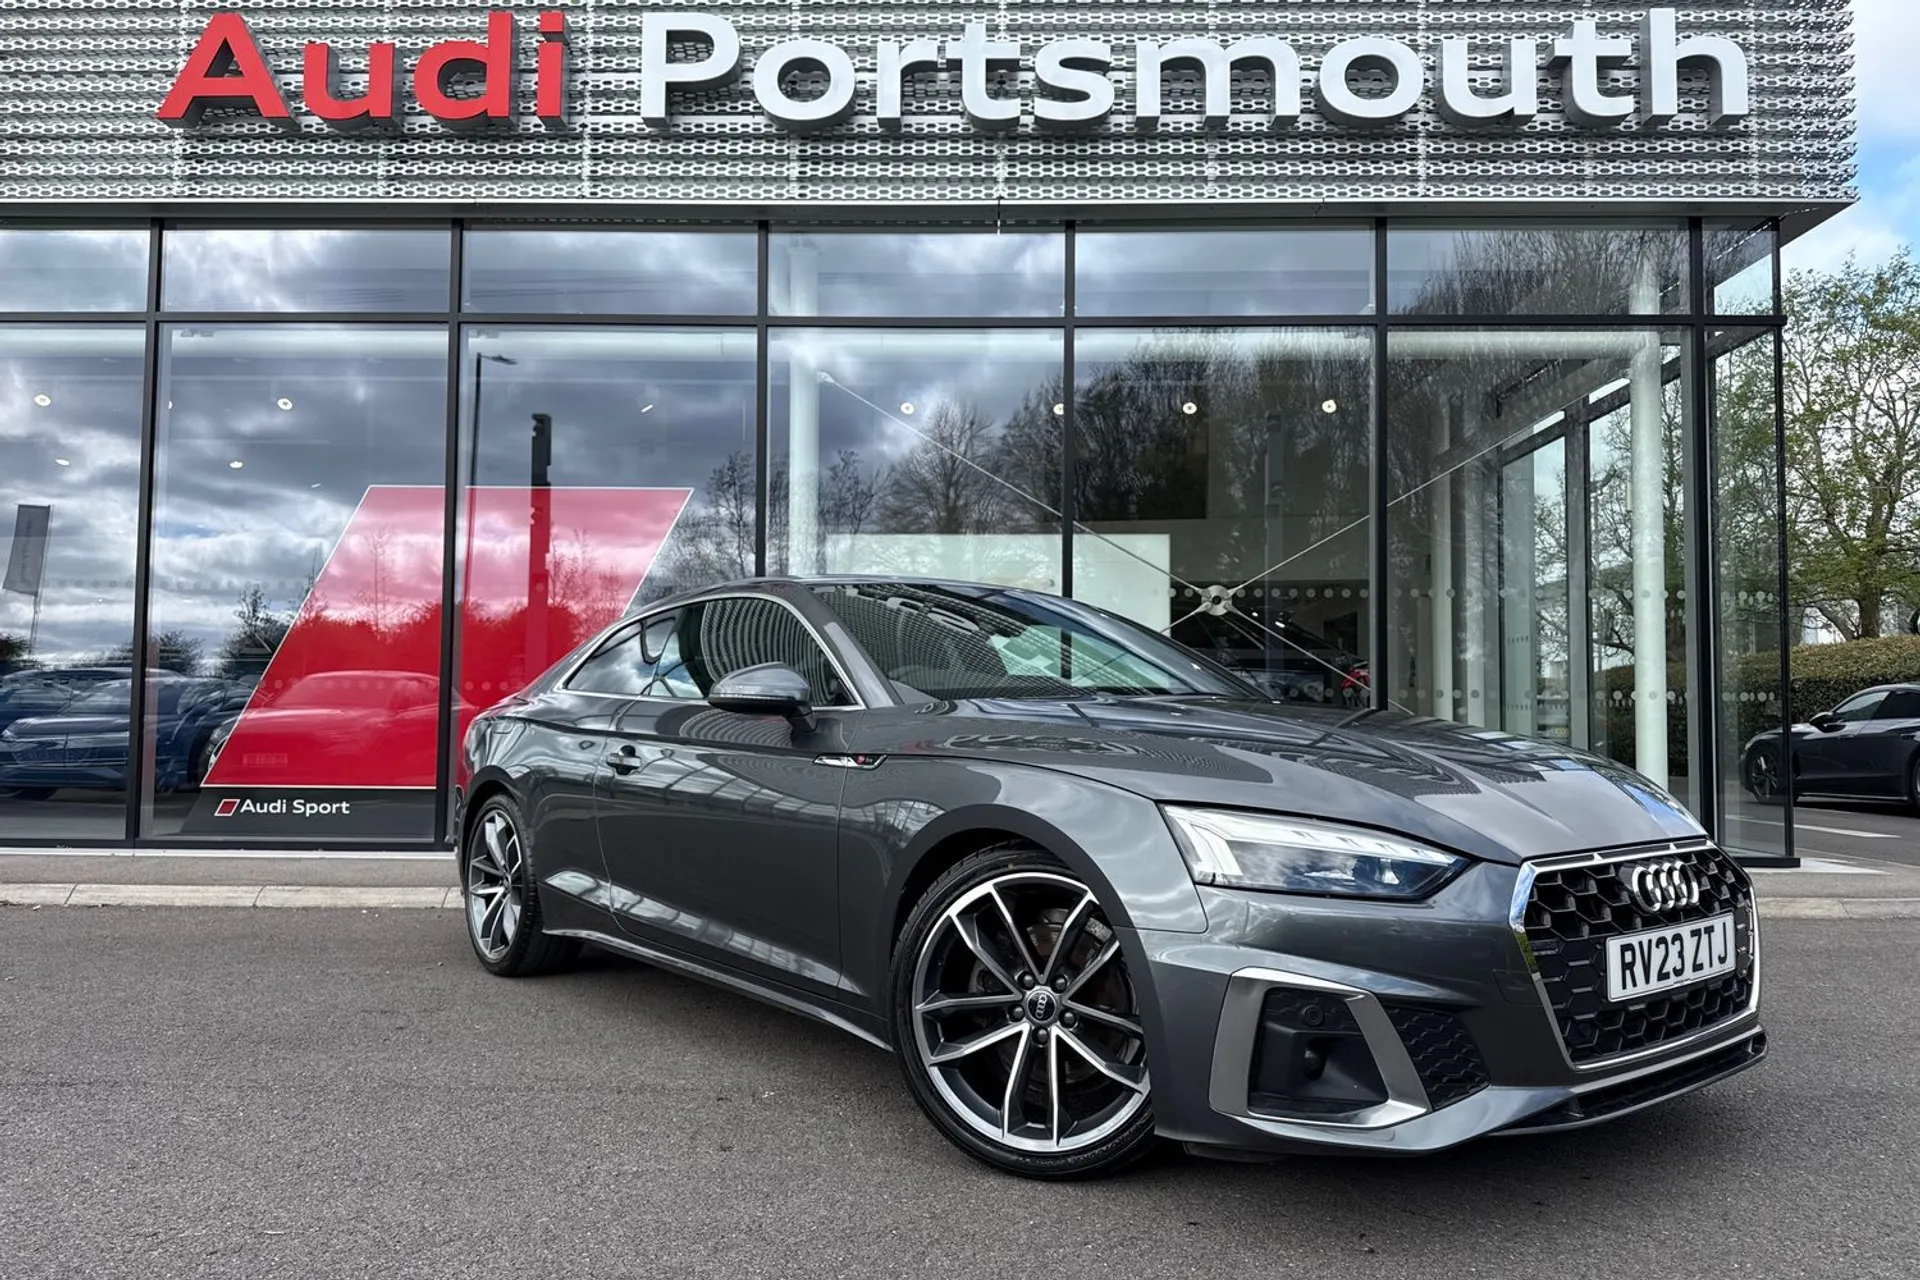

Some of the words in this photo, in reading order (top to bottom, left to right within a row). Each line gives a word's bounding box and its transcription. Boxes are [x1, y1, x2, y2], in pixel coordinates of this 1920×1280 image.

[157, 11, 568, 124] Audi
[640, 8, 1750, 126] Portsmouth
[240, 799, 287, 813] Audi
[292, 799, 350, 817] Sport
[1620, 932, 1685, 990] RV23
[1690, 921, 1728, 973] ZTJ
